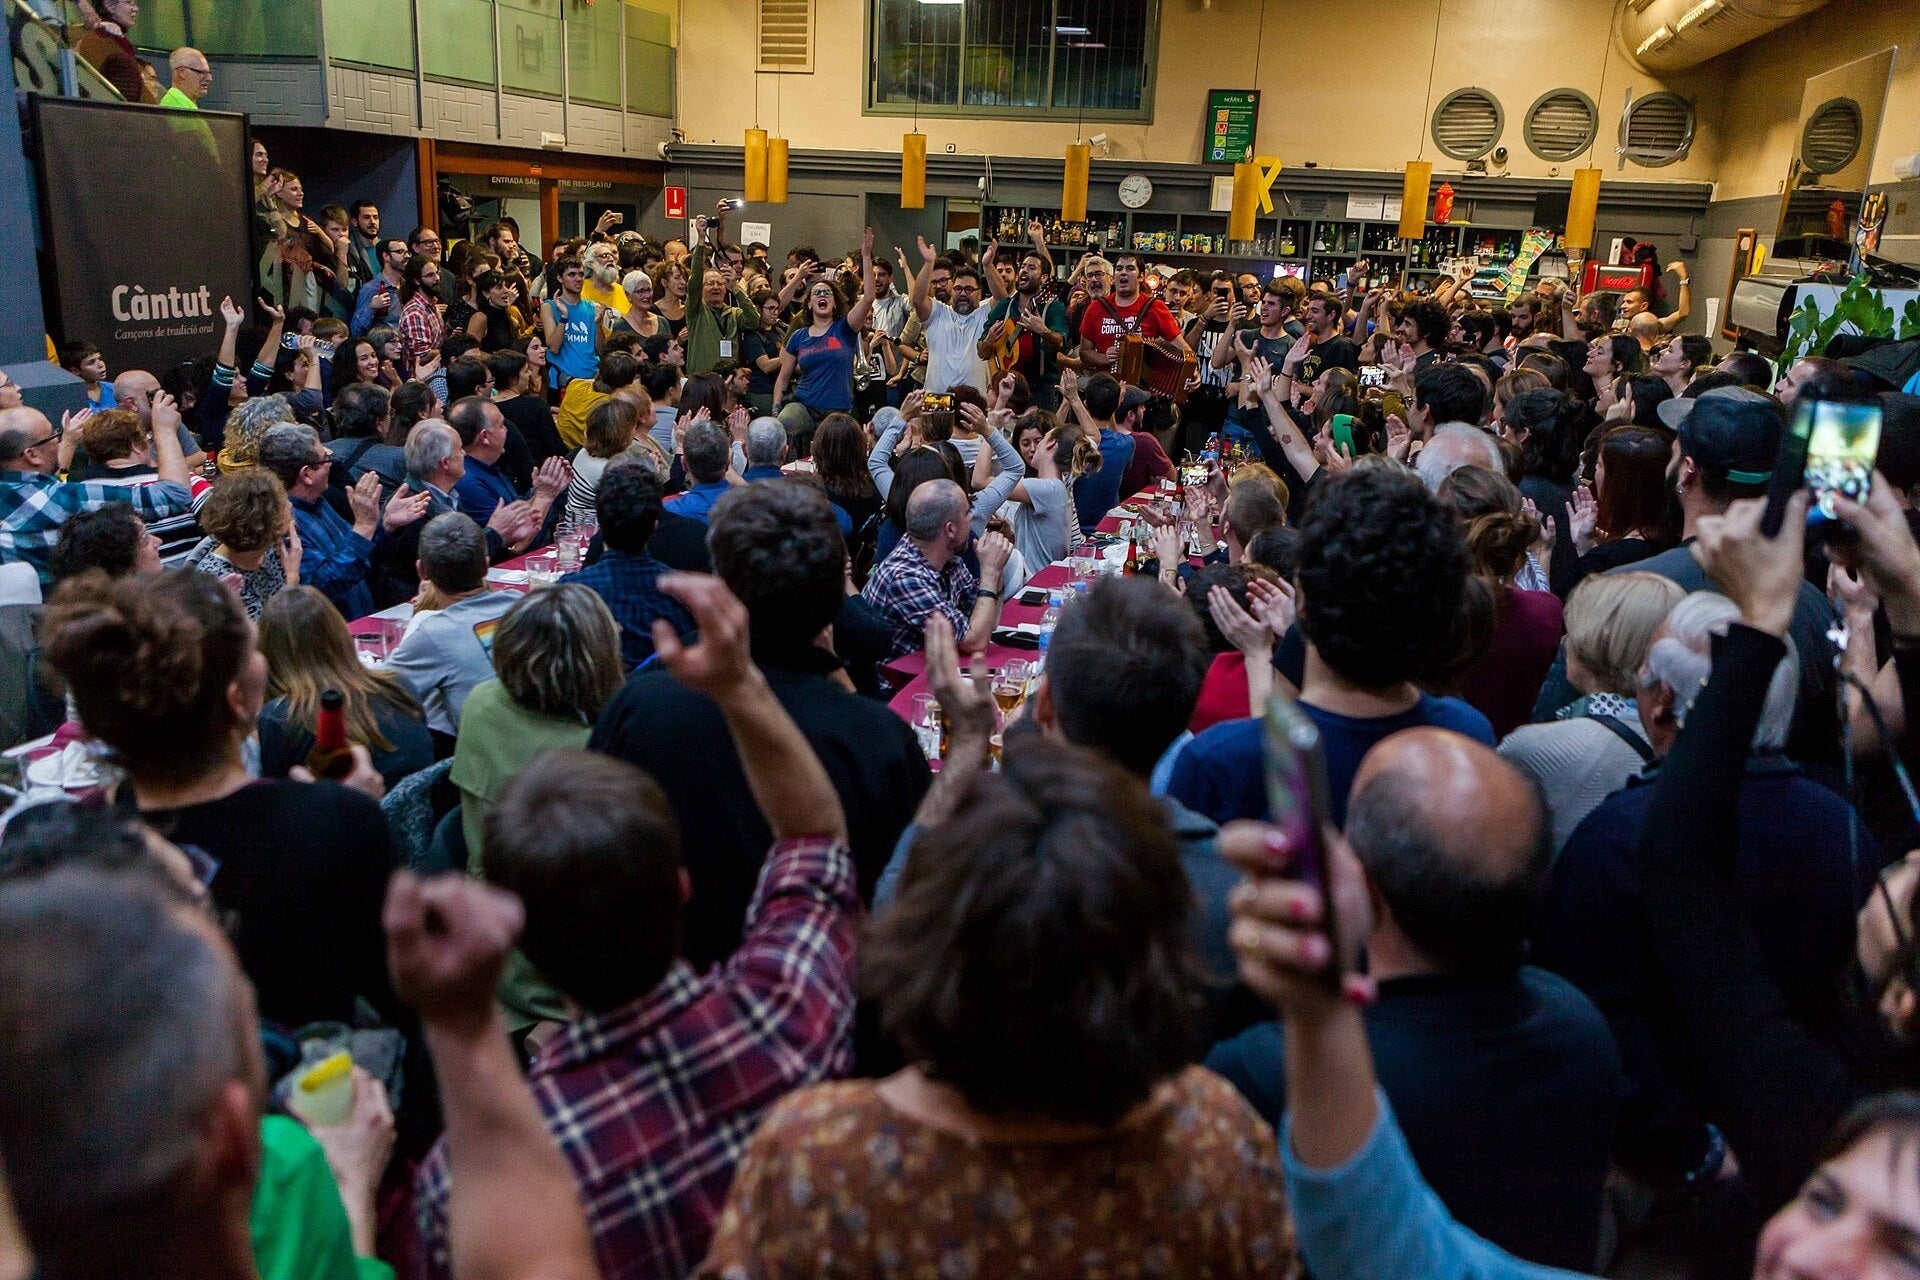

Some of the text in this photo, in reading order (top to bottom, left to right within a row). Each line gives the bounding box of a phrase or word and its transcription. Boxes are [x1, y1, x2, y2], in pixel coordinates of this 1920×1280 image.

[491, 176, 523, 184] ENTRADA
[558, 179, 572, 187] TRE
[573, 180, 612, 188] RECREATIU
[112, 284, 213, 321] Càntut
[115, 322, 214, 341] Cançons de tradició oral
